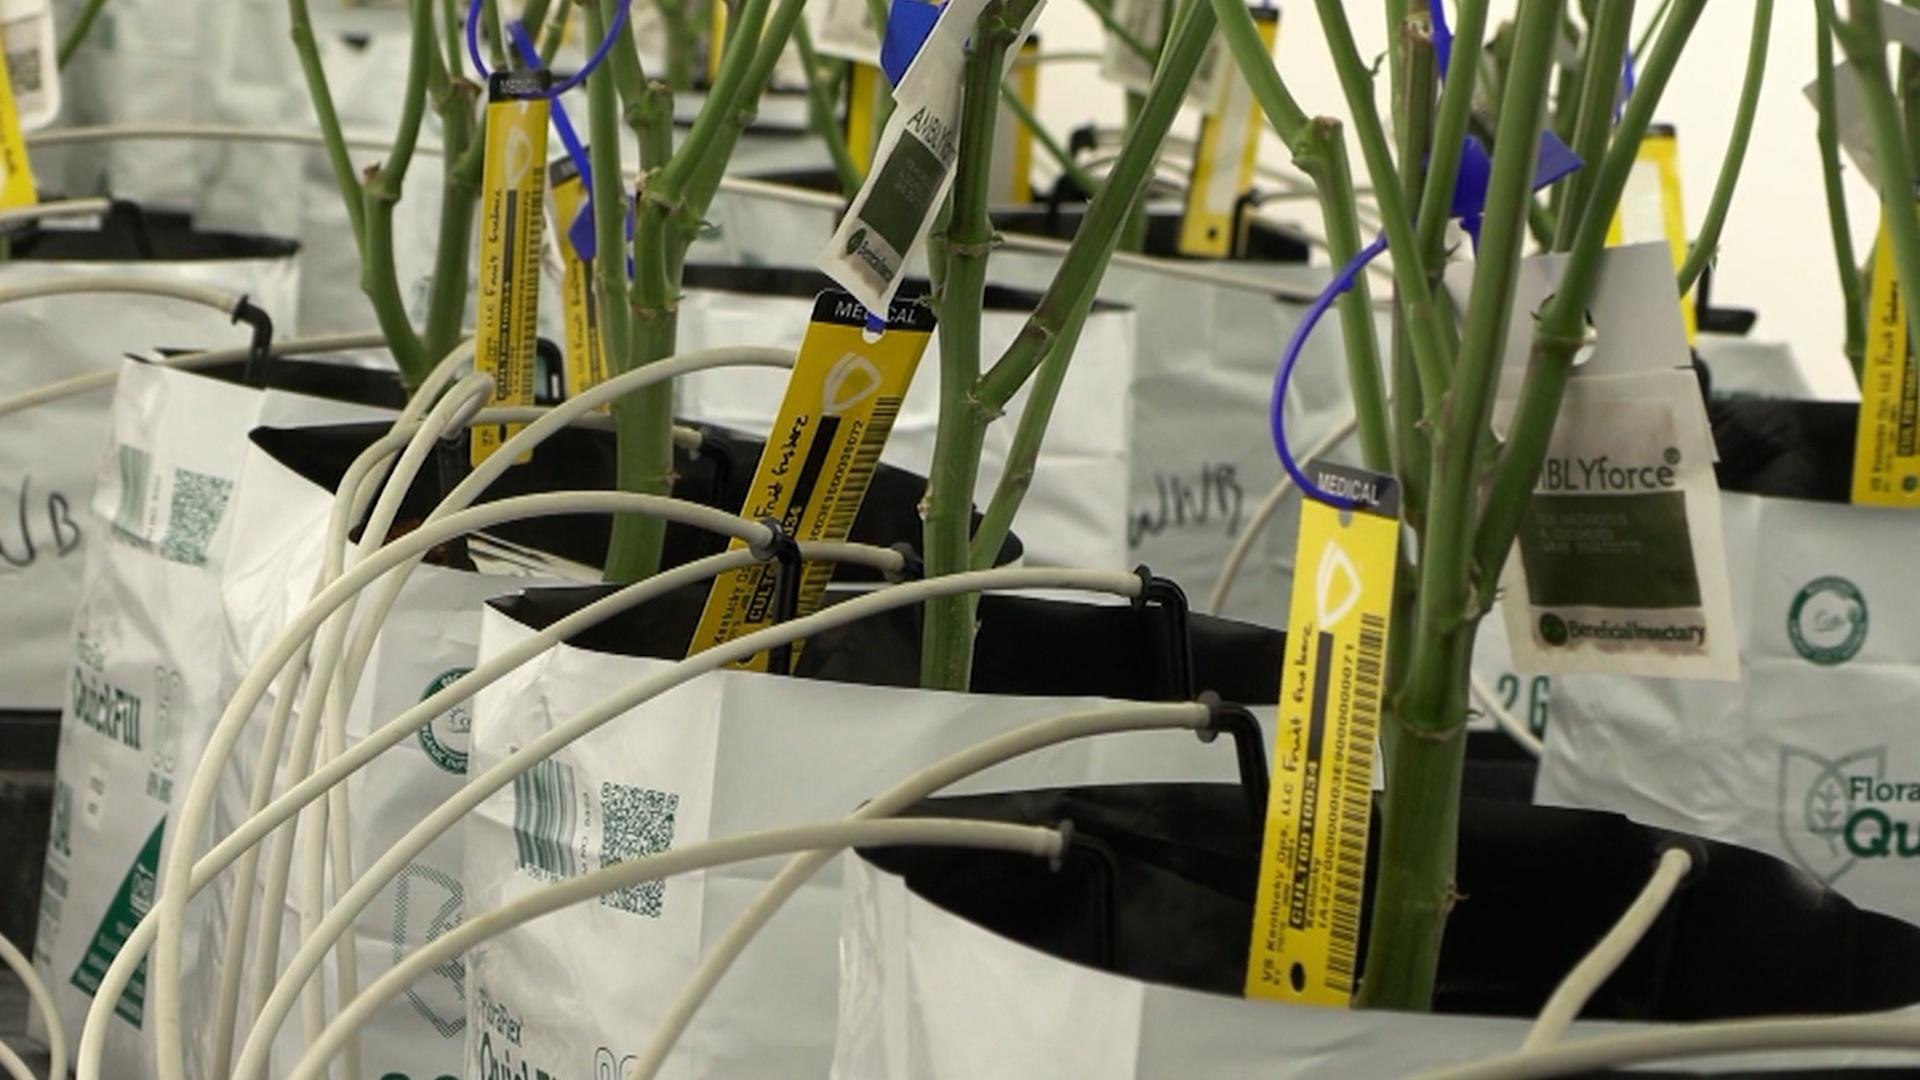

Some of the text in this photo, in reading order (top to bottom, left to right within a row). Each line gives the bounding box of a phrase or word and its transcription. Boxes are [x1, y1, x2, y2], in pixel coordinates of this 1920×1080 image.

[834, 301, 917, 325] MECAL
[1318, 472, 1380, 506] MEDICAL
[1266, 870, 1285, 951] Kentucky
[1281, 782, 1294, 816] LLC
[1291, 760, 1319, 927] CULT0010034
